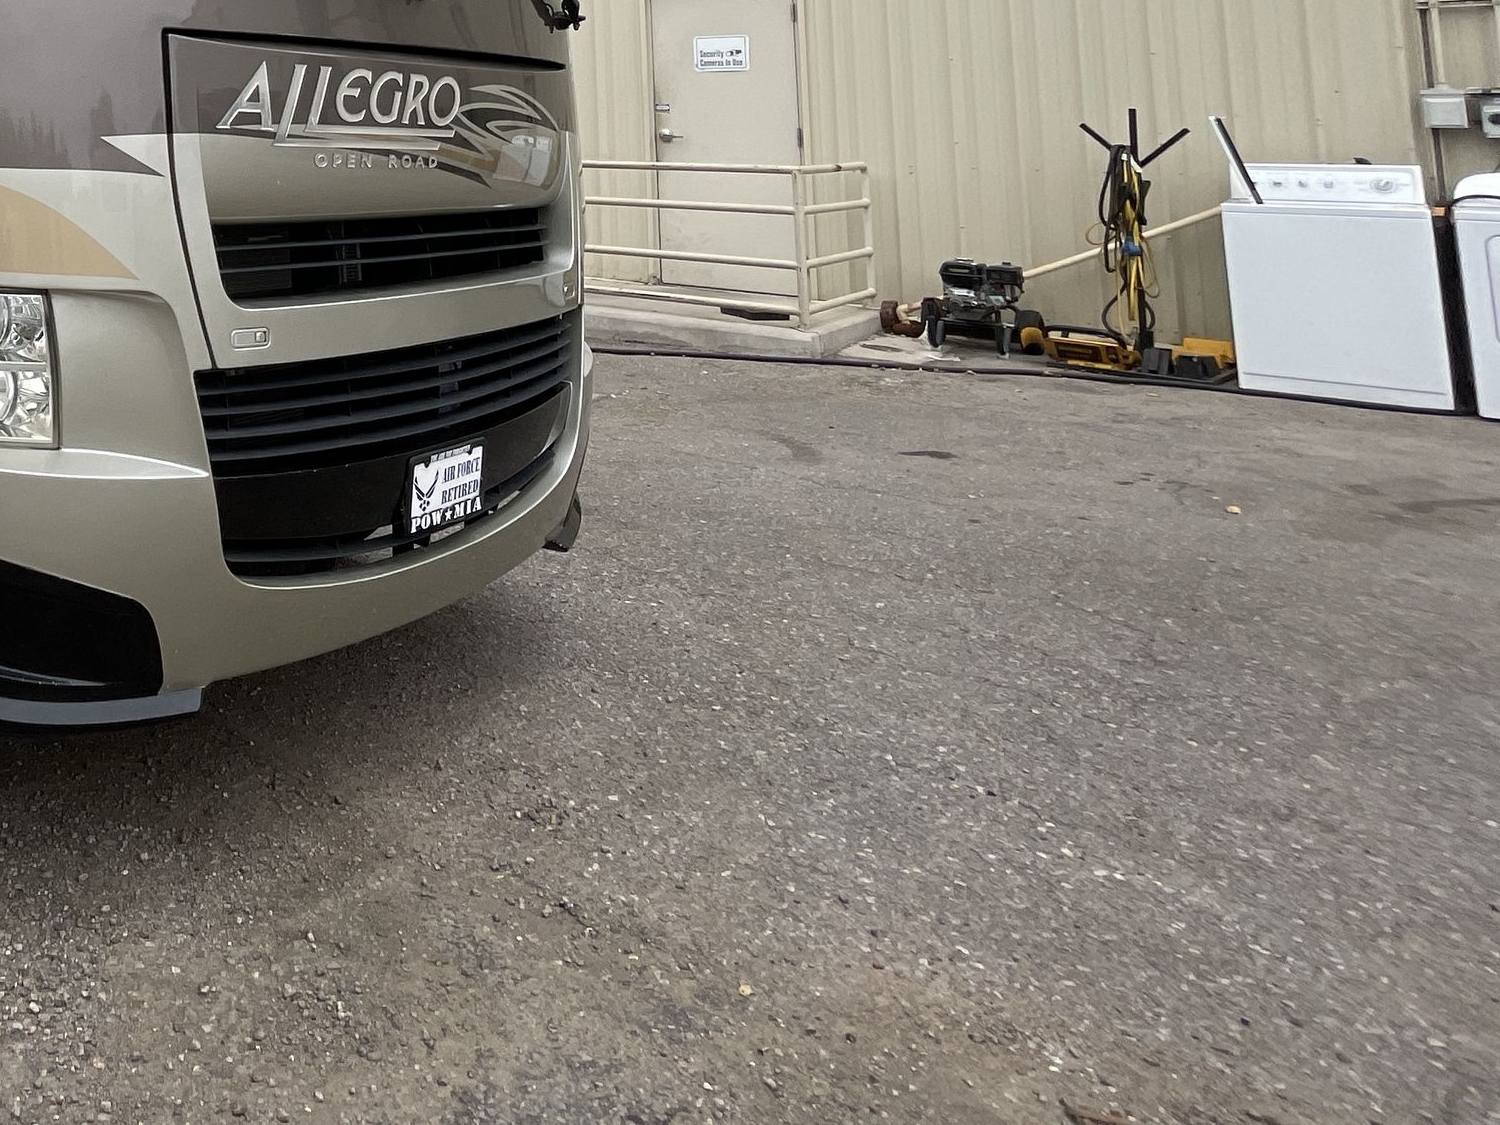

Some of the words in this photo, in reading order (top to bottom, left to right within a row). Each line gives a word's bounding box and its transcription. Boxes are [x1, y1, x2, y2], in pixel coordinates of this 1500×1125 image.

[700, 50, 724, 58] Security
[216, 60, 461, 150] ALLEGRO
[314, 153, 373, 169] OPEN
[388, 154, 438, 170] ROAD
[443, 465, 456, 483] AIR
[457, 457, 481, 478] FORCE
[441, 479, 479, 505] RETIRED
[411, 510, 442, 533] POW
[453, 496, 482, 519] MIA
